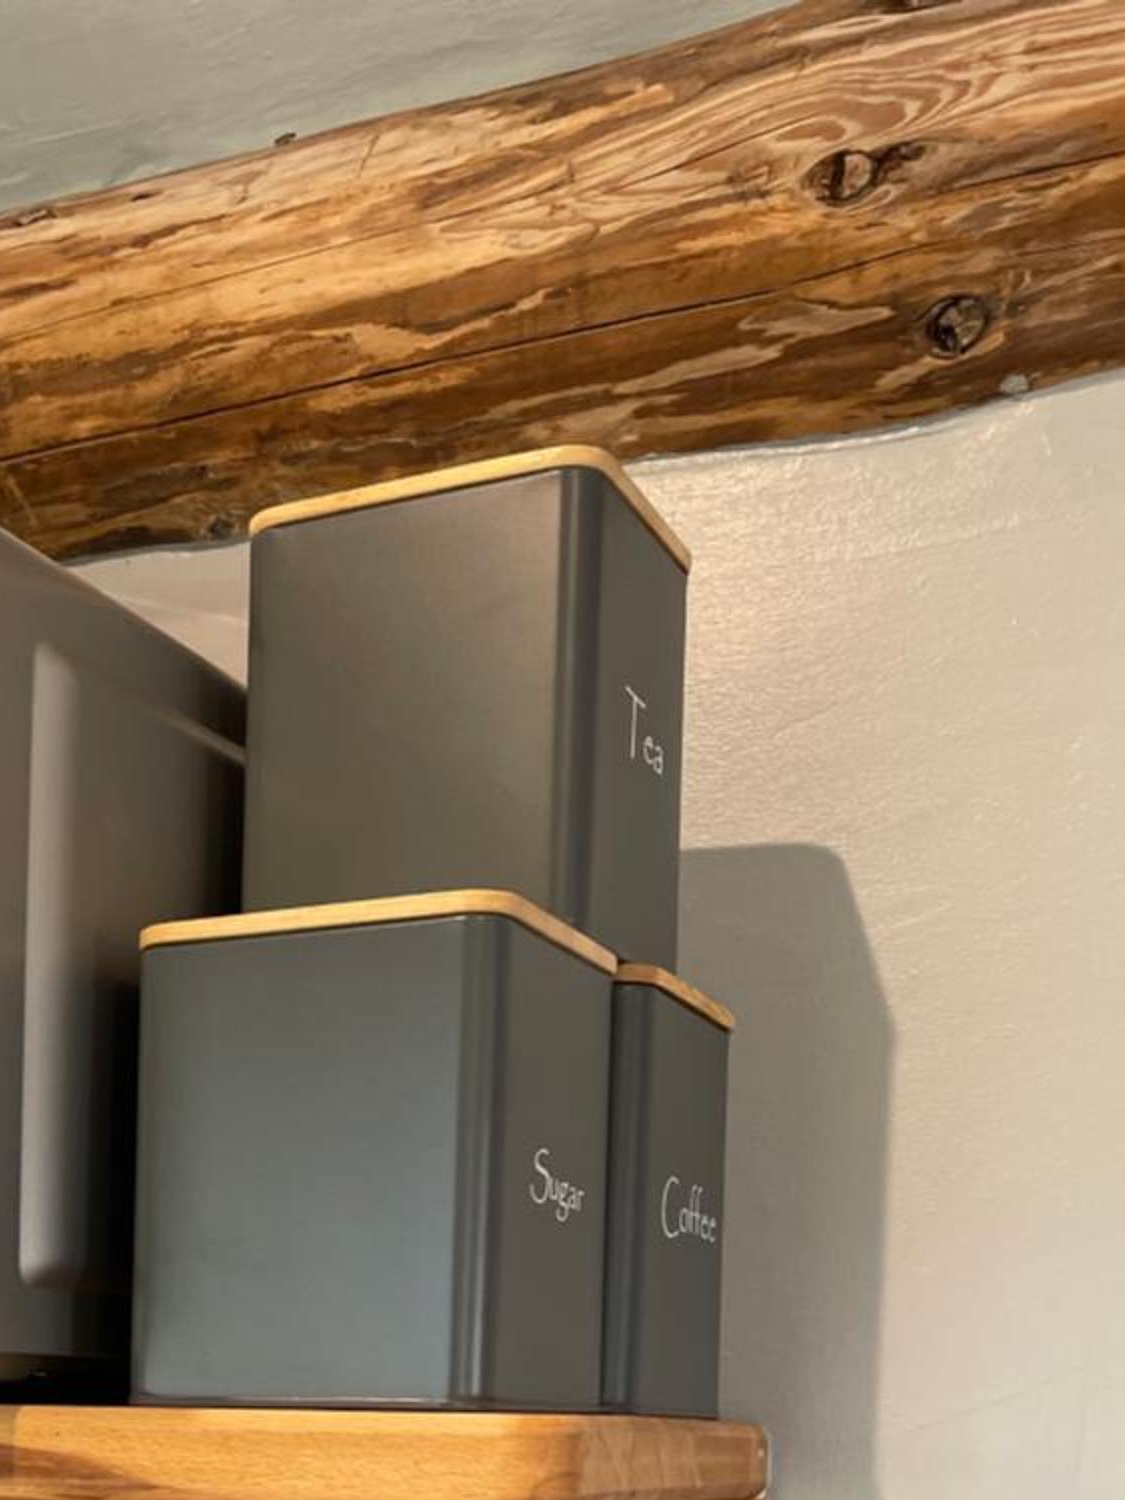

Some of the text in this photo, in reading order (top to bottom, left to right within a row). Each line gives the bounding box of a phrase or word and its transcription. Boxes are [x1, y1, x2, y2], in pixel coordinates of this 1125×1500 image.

[624, 684, 664, 774] Tea
[529, 1147, 586, 1222] Sugar
[660, 1174, 717, 1244] Coffee
